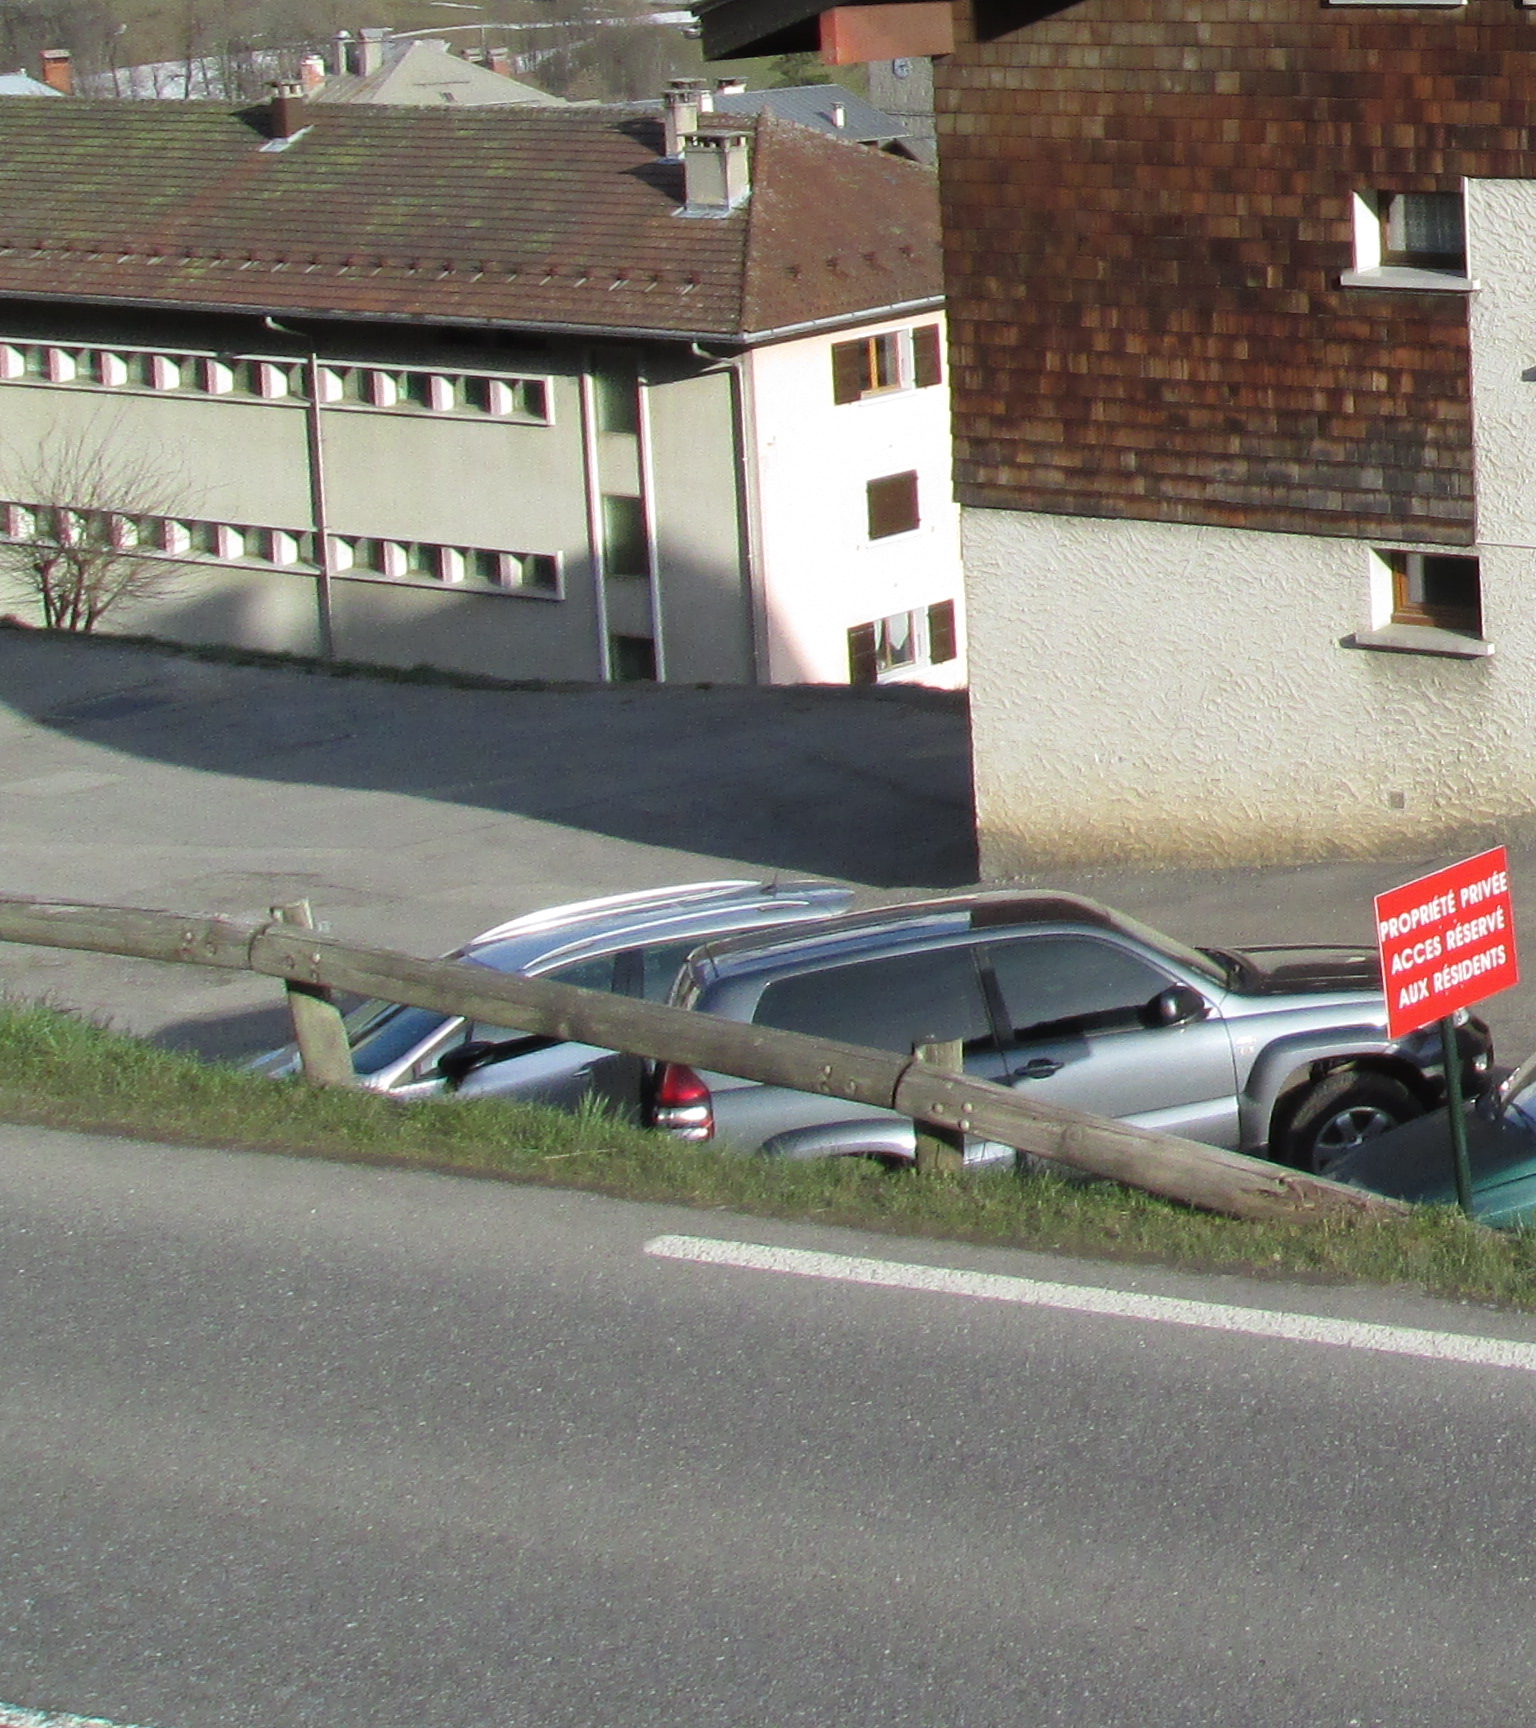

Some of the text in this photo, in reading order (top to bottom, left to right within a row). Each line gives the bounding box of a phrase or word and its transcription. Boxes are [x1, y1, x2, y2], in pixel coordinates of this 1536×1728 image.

[1379, 870, 1508, 942] PROPRIÉTÉ PRIVÉE
[1391, 905, 1506, 974] ACCES RÉSERVÉ
[1399, 944, 1507, 1009] AUX RÉSIDENTS
